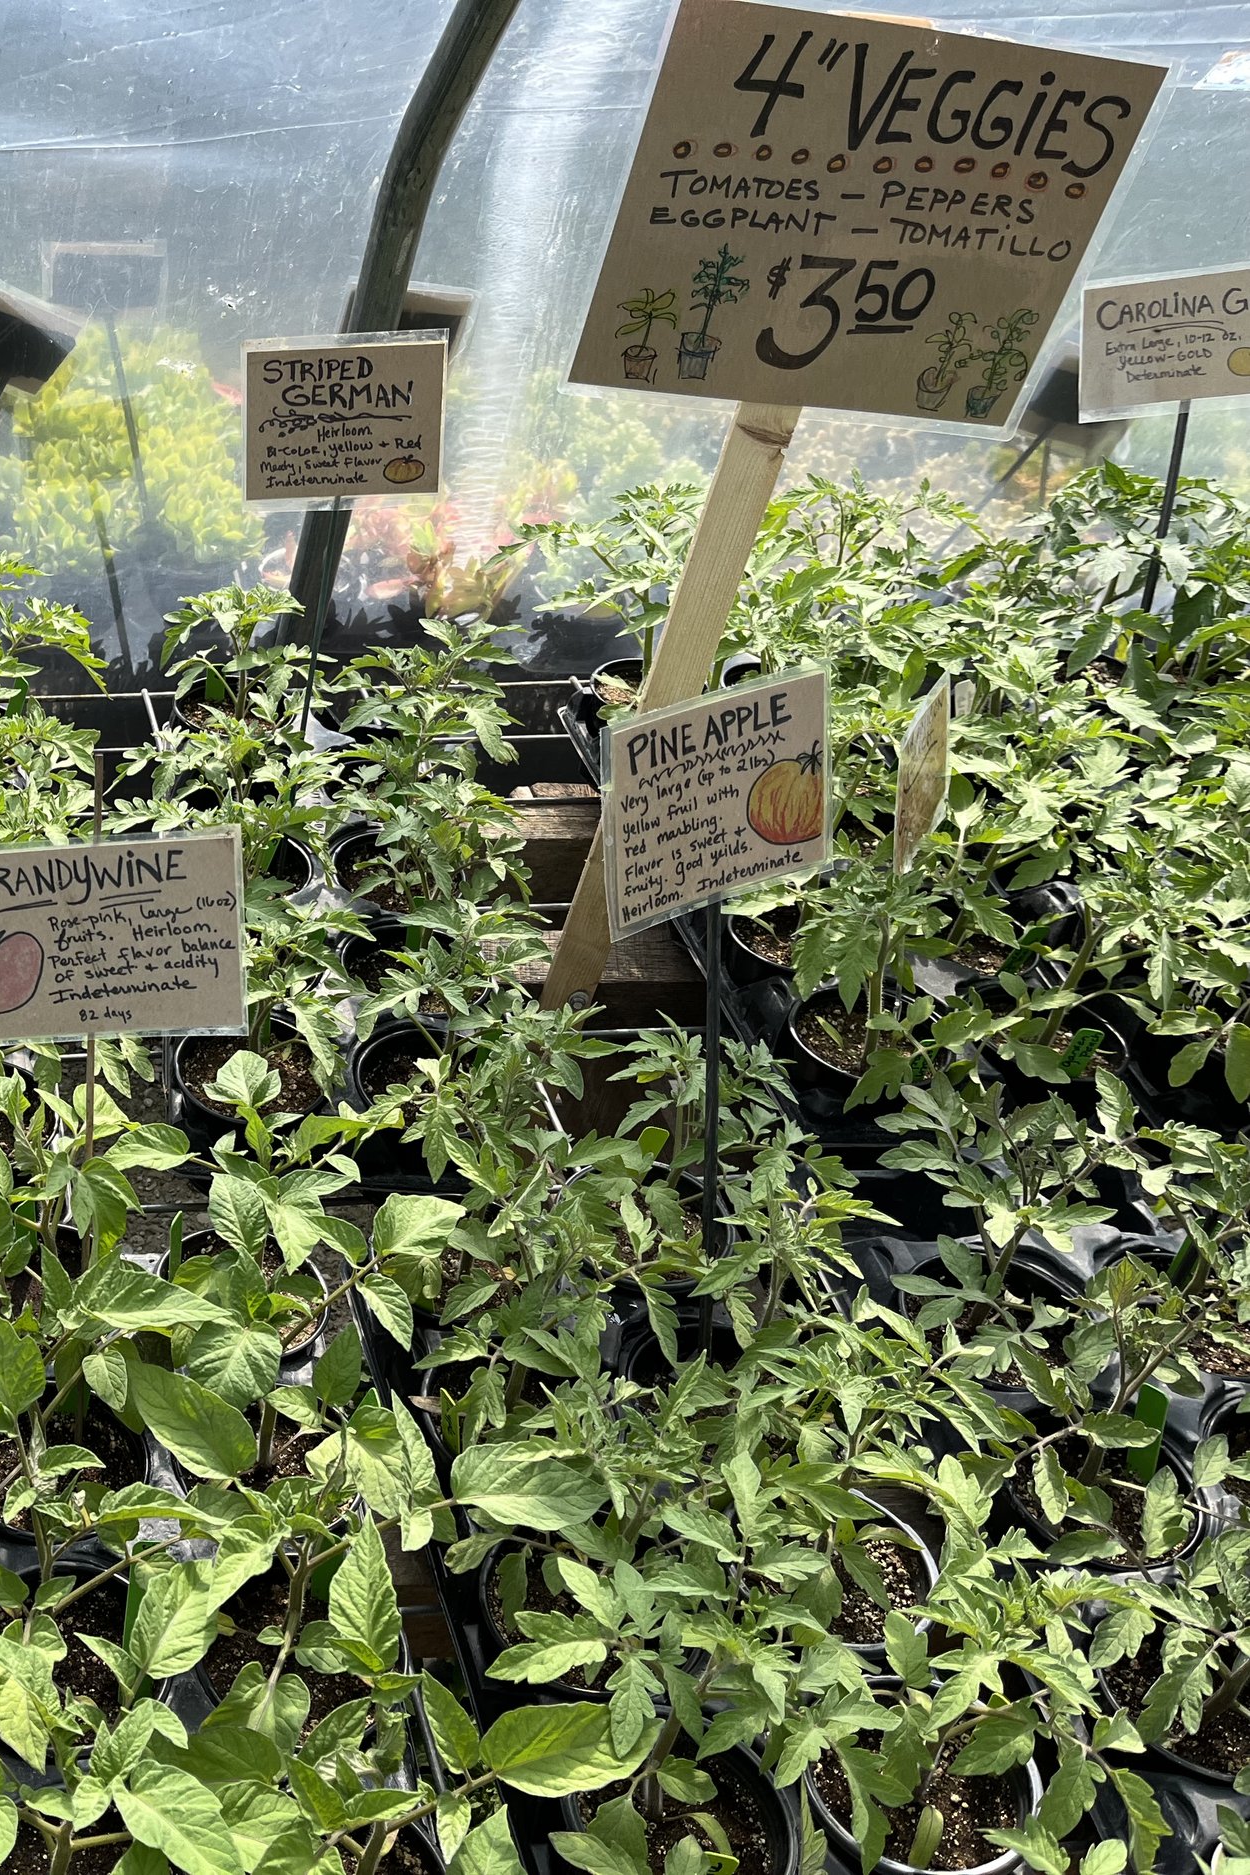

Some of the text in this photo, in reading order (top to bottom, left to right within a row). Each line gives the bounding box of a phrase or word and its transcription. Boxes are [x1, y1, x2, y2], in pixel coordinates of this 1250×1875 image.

[847, 41, 1131, 178] VEGGIES
[660, 167, 822, 201] TOMATOES
[879, 180, 1036, 225] PEPPERS
[650, 206, 837, 237] EGGPLANT
[890, 216, 1072, 262] TOMATILLO
[1096, 291, 1215, 331] CAROLINA
[1105, 342, 1136, 356] Extra
[1185, 334, 1215, 344] 10-12
[263, 356, 374, 384] STRIPED
[1126, 365, 1207, 383] Determinate
[281, 381, 414, 410] GERMAN
[395, 435, 422, 450] Red
[266, 472, 369, 489] Indeterminate
[657, 778, 691, 802] large
[719, 764, 731, 776] to
[737, 759, 748, 771] 2
[707, 785, 739, 805] with
[625, 816, 723, 858] red marbling.
[624, 858, 663, 881] Flavor
[672, 849, 682, 861] is
[689, 829, 728, 852] sweet
[622, 849, 803, 923] Heirloom. Indeterminate
[132, 921, 218, 942] Heirloom.
[181, 938, 236, 953] balance
[55, 972, 75, 984] of
[164, 954, 219, 978] acidity
[49, 975, 197, 1004] Indeterminate
[79, 1006, 132, 1024] 82 days
